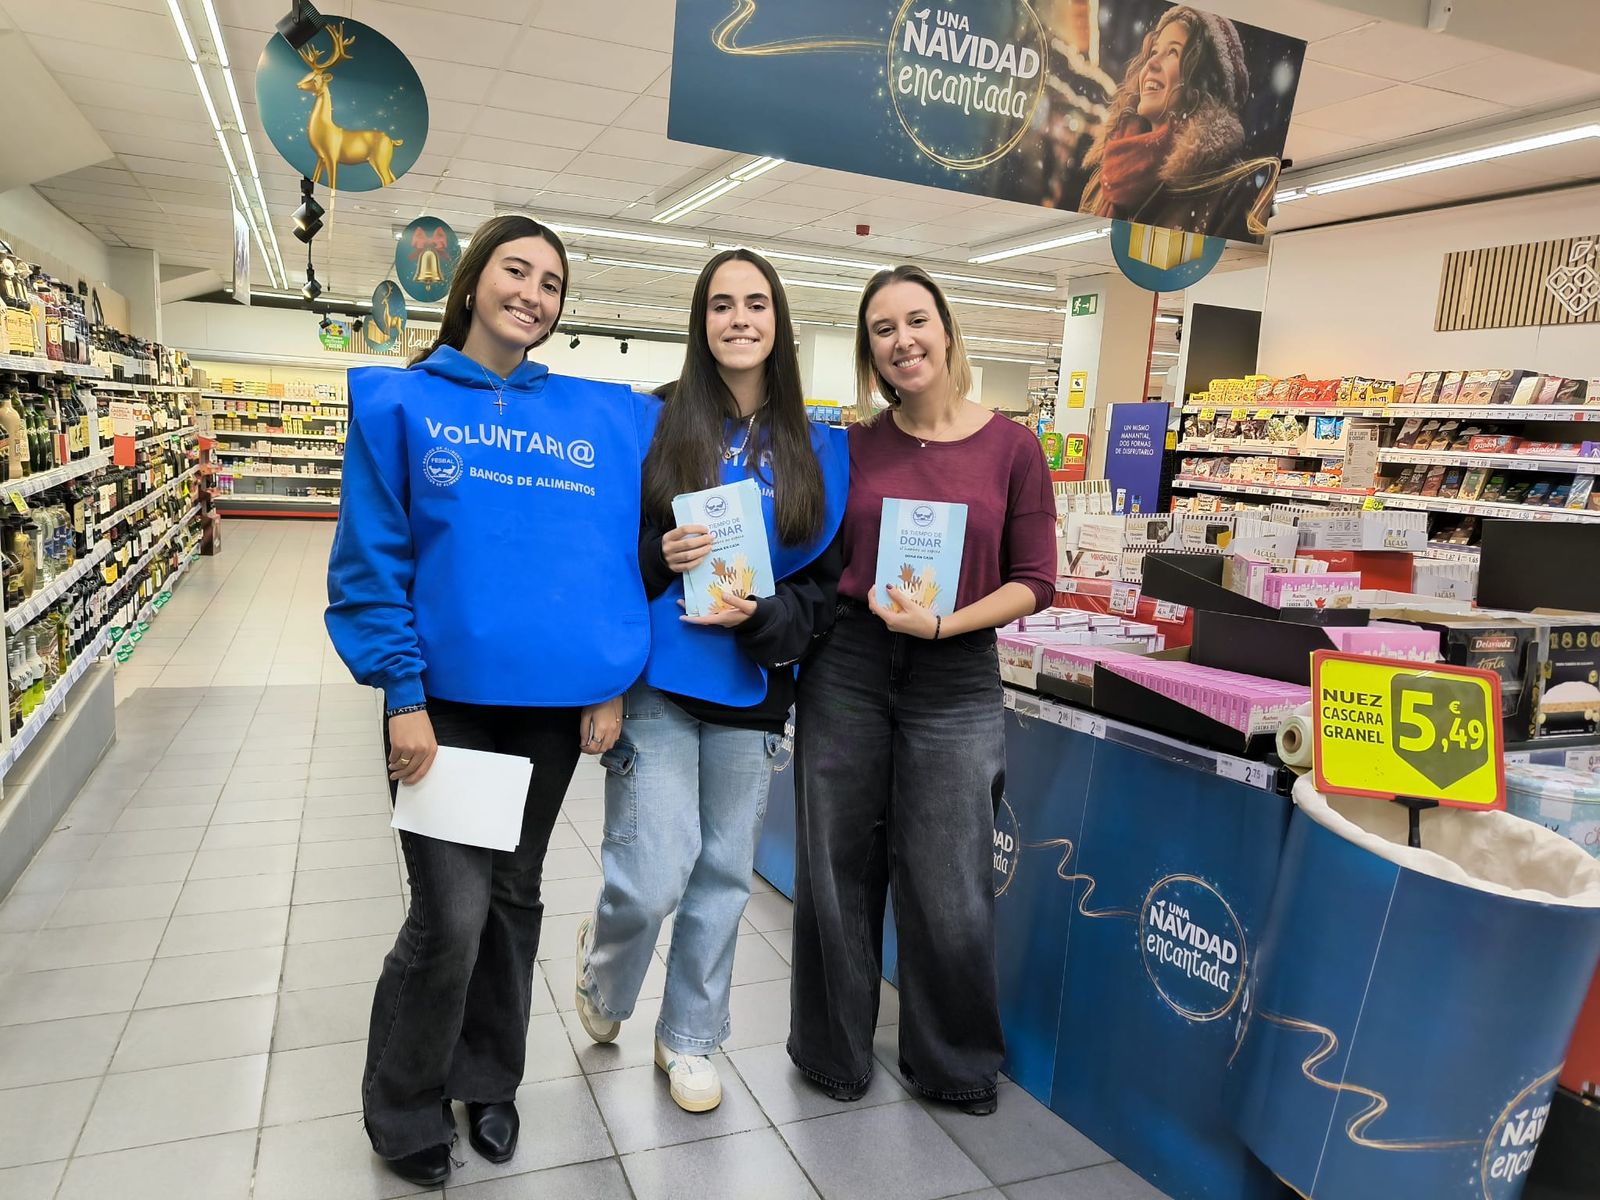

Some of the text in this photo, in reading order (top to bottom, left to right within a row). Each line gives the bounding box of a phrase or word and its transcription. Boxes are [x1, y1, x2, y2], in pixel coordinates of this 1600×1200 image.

[936, 9, 970, 32] UNA
[903, 20, 1040, 79] NAVIDAD
[898, 64, 1027, 119] encantada
[425, 416, 595, 469] VOLUNTARI@
[469, 466, 596, 497] BANCOS DE ALIMENTOS
[709, 524, 743, 539] ONAR
[900, 535, 942, 548] DONAR
[1091, 553, 1118, 561] VIRGINIAS
[1475, 639, 1511, 649] Delaviuda
[1322, 688, 1383, 708] NUEZ
[1322, 706, 1384, 726] CASCARA
[1323, 724, 1384, 744] GRANEL
[1168, 902, 1190, 921] UNA
[1150, 905, 1238, 965] NAVIDAD
[1146, 933, 1230, 993] encantada
